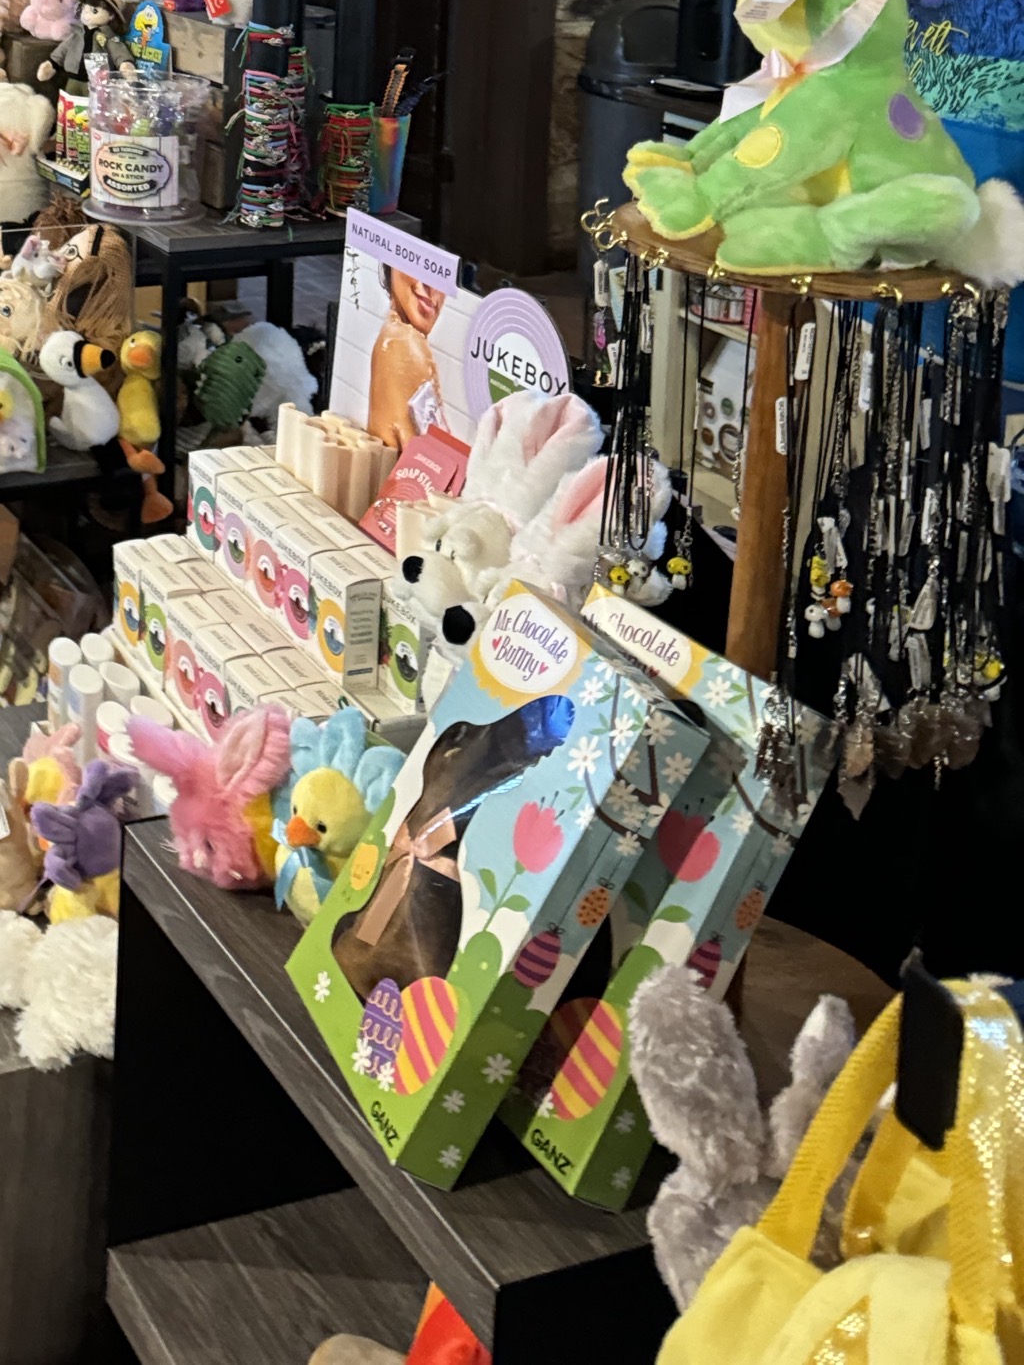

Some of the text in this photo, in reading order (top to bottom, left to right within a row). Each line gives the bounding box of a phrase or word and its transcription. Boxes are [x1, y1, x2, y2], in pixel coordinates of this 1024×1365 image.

[98, 158, 123, 172] ROCK
[125, 163, 164, 174] CANDY
[106, 179, 150, 192] ASSORTED
[351, 223, 451, 280] NATURAL BODY SOAP
[470, 336, 567, 397] JUKEBOX
[395, 467, 437, 496] SOAP STAC
[494, 635, 540, 682] Bunny
[512, 609, 570, 665] Chocolate
[370, 1100, 400, 1148] GANZ
[530, 1128, 575, 1177] GANZ
